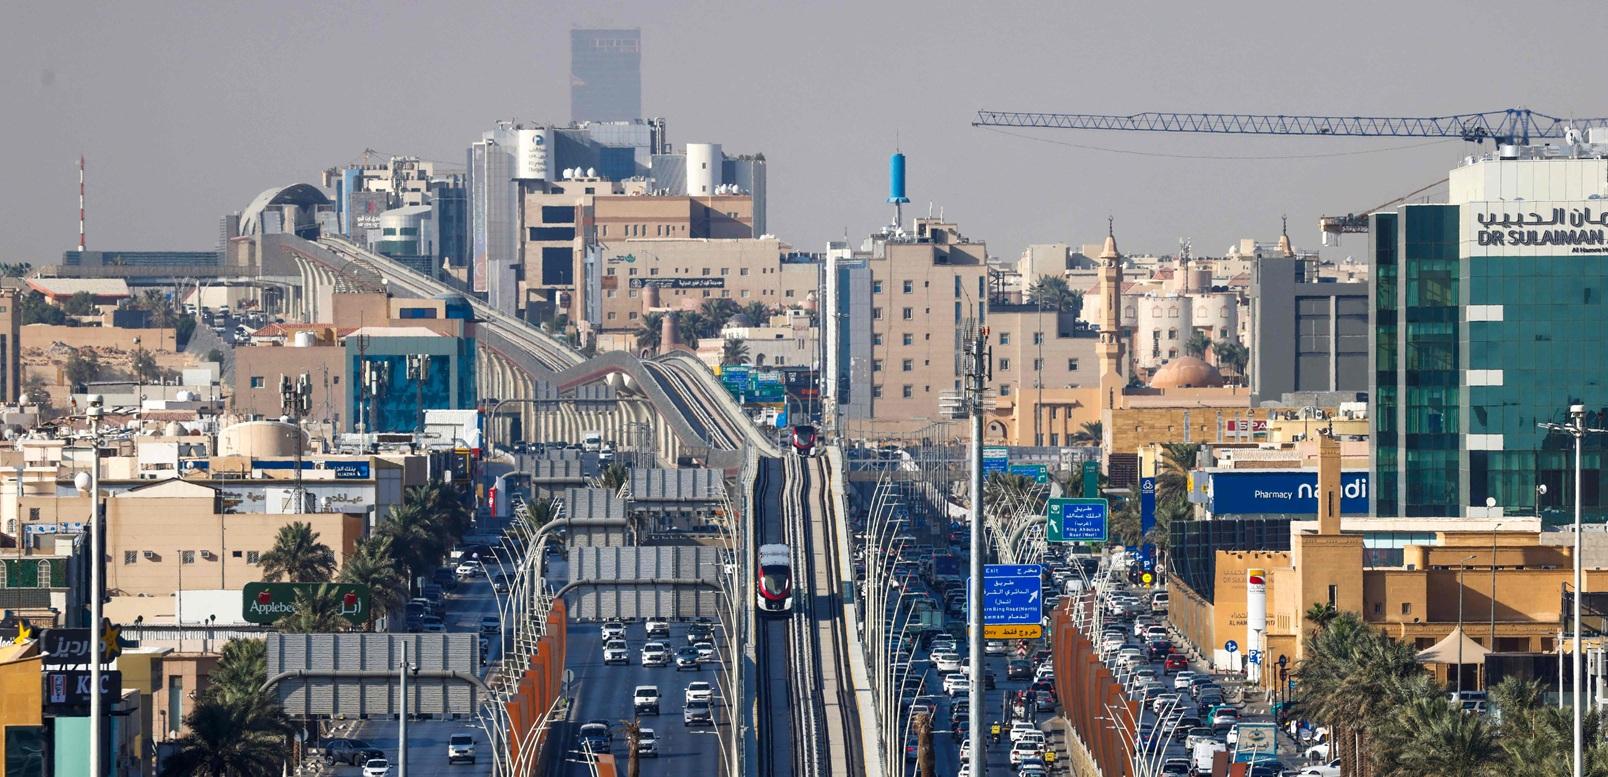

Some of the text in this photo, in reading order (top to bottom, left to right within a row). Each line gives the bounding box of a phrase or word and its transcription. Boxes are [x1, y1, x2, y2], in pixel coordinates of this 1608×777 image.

[1478, 207, 1566, 229] الحبيب
[1478, 230, 1604, 246] DR SULAIMAN
[1254, 478, 1367, 500] Pharmacy ndi
[993, 579, 1014, 587] طريق
[76, 675, 109, 694] KC
